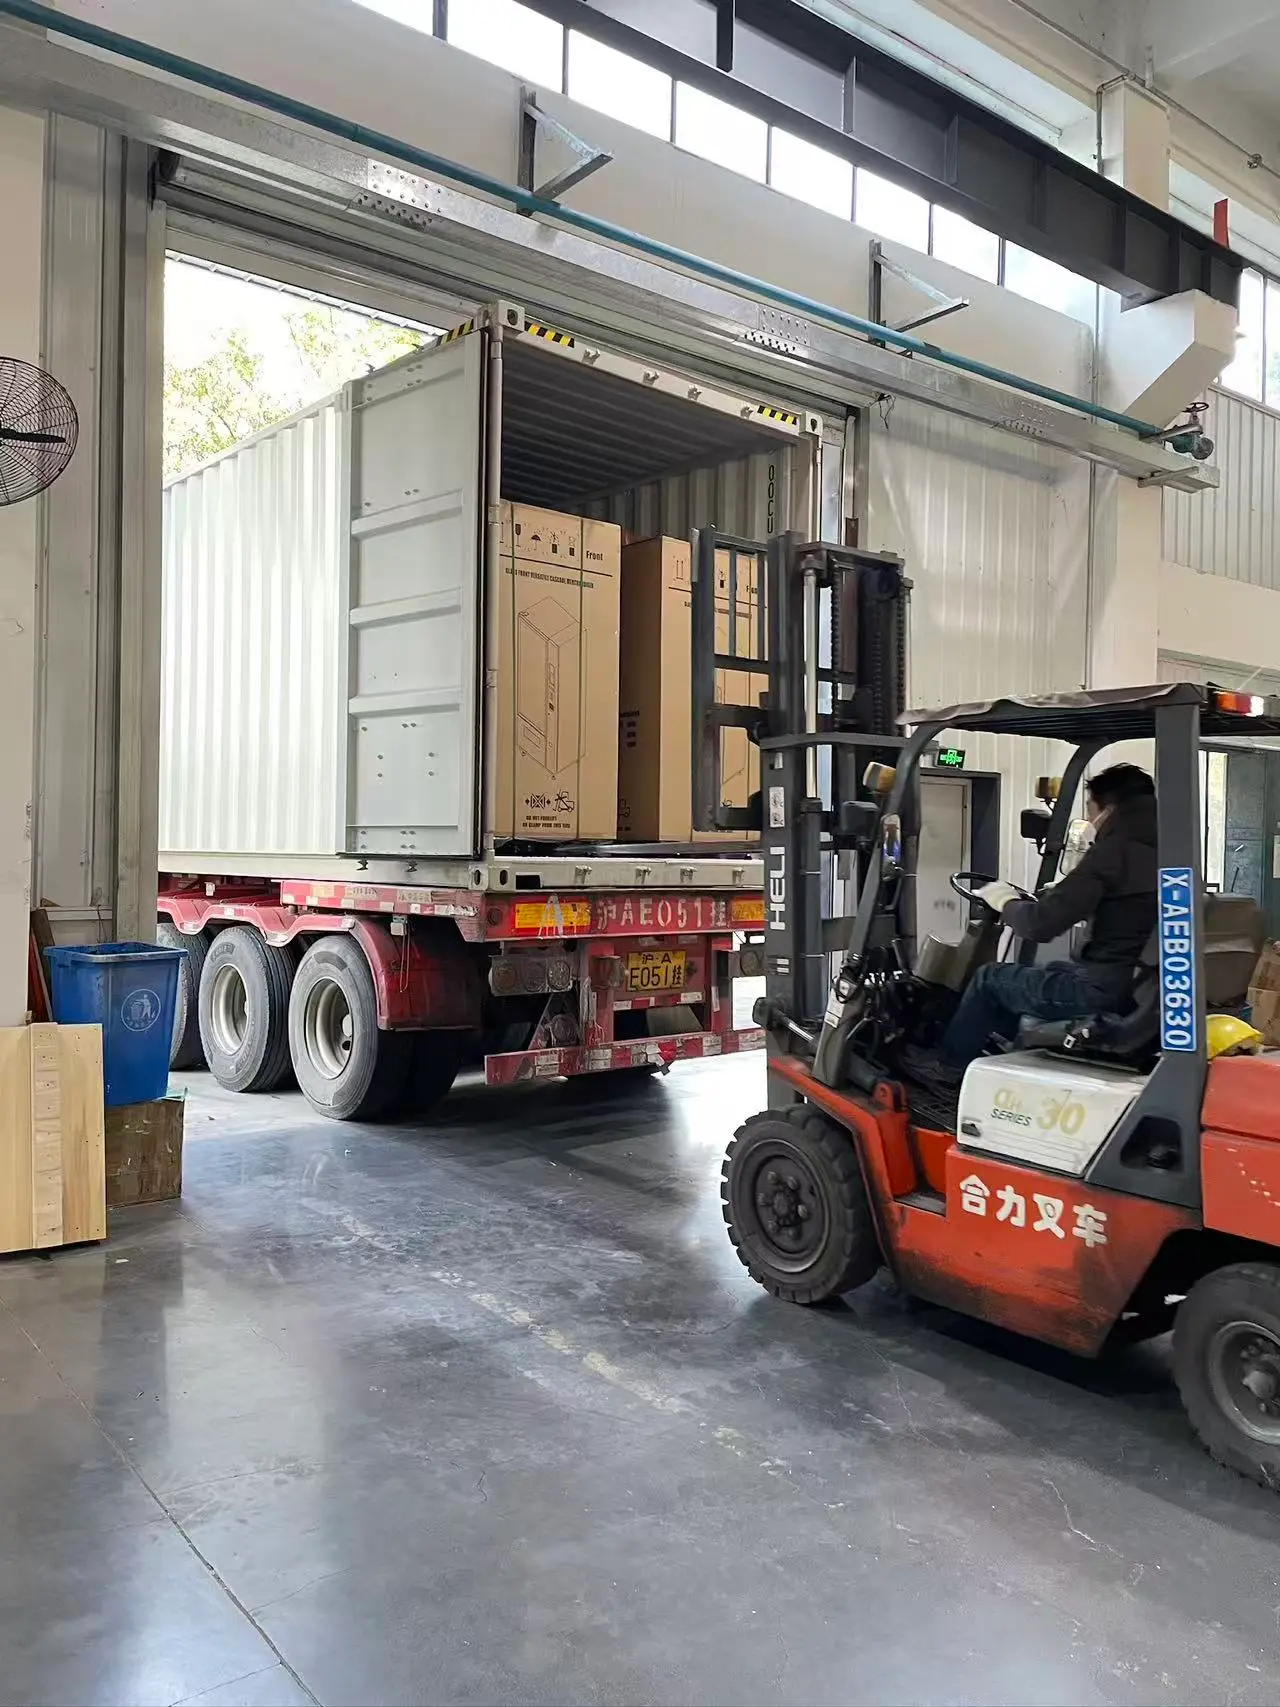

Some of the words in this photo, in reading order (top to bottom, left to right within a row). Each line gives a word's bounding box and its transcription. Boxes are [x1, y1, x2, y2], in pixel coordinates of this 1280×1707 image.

[586, 550, 604, 561] Front
[769, 846, 786, 931] HELI
[630, 965, 682, 987] E051挂
[1162, 874, 1192, 1047] X-AEB03630
[990, 1108, 1033, 1127] SERIES
[1036, 1098, 1086, 1135] 30
[959, 1174, 1108, 1248] 合力叉车
